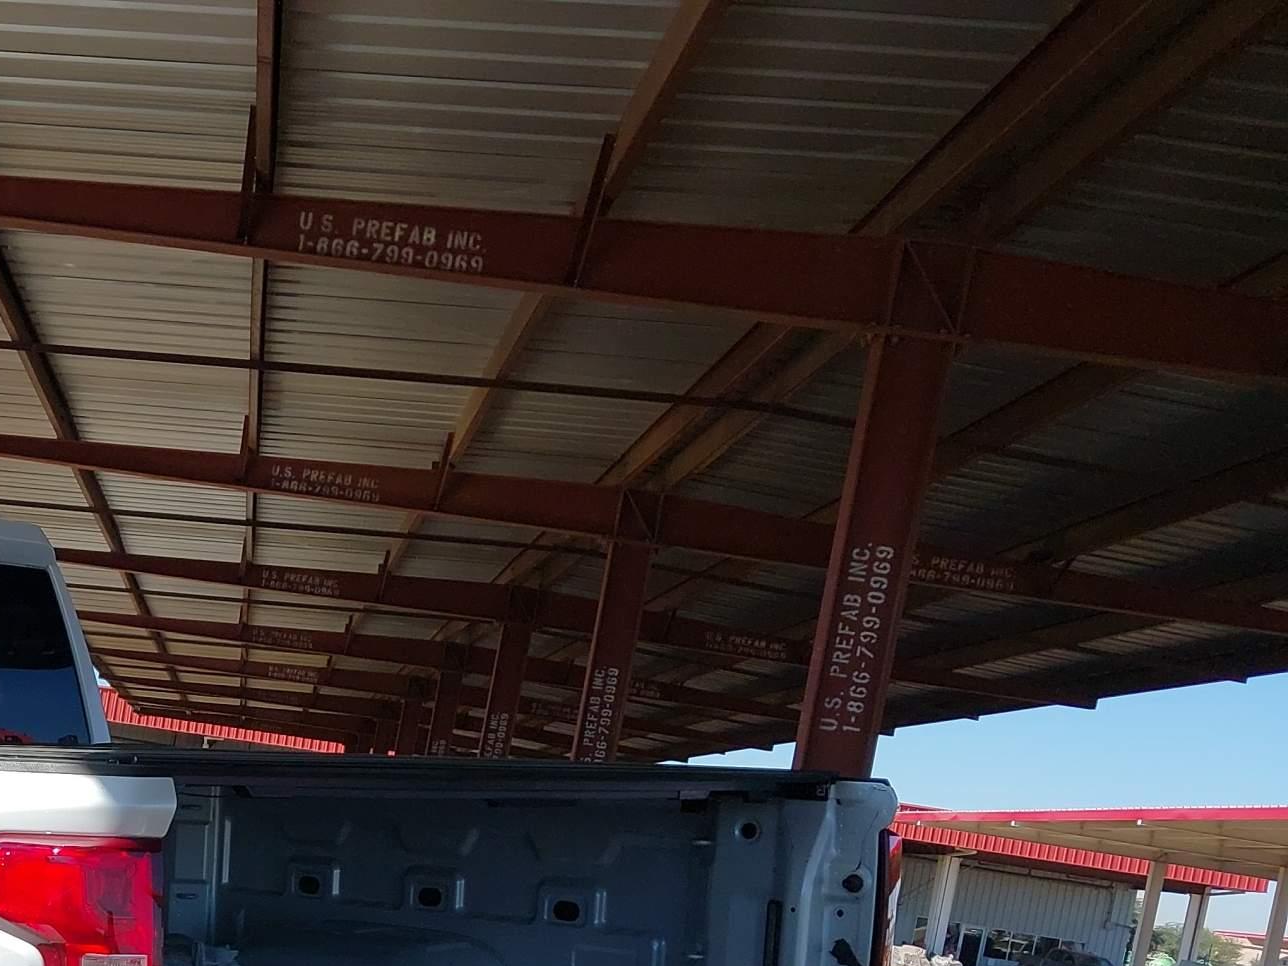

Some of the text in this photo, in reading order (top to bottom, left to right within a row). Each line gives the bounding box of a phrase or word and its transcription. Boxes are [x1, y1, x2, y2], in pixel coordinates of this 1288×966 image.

[298, 234, 484, 273] 1-866-799-0969
[352, 217, 437, 246] PREFAB
[818, 542, 873, 732] U.S. PREFAB INC.
[842, 546, 895, 733] 1-866-799-0969
[583, 696, 601, 747] PREFAB
